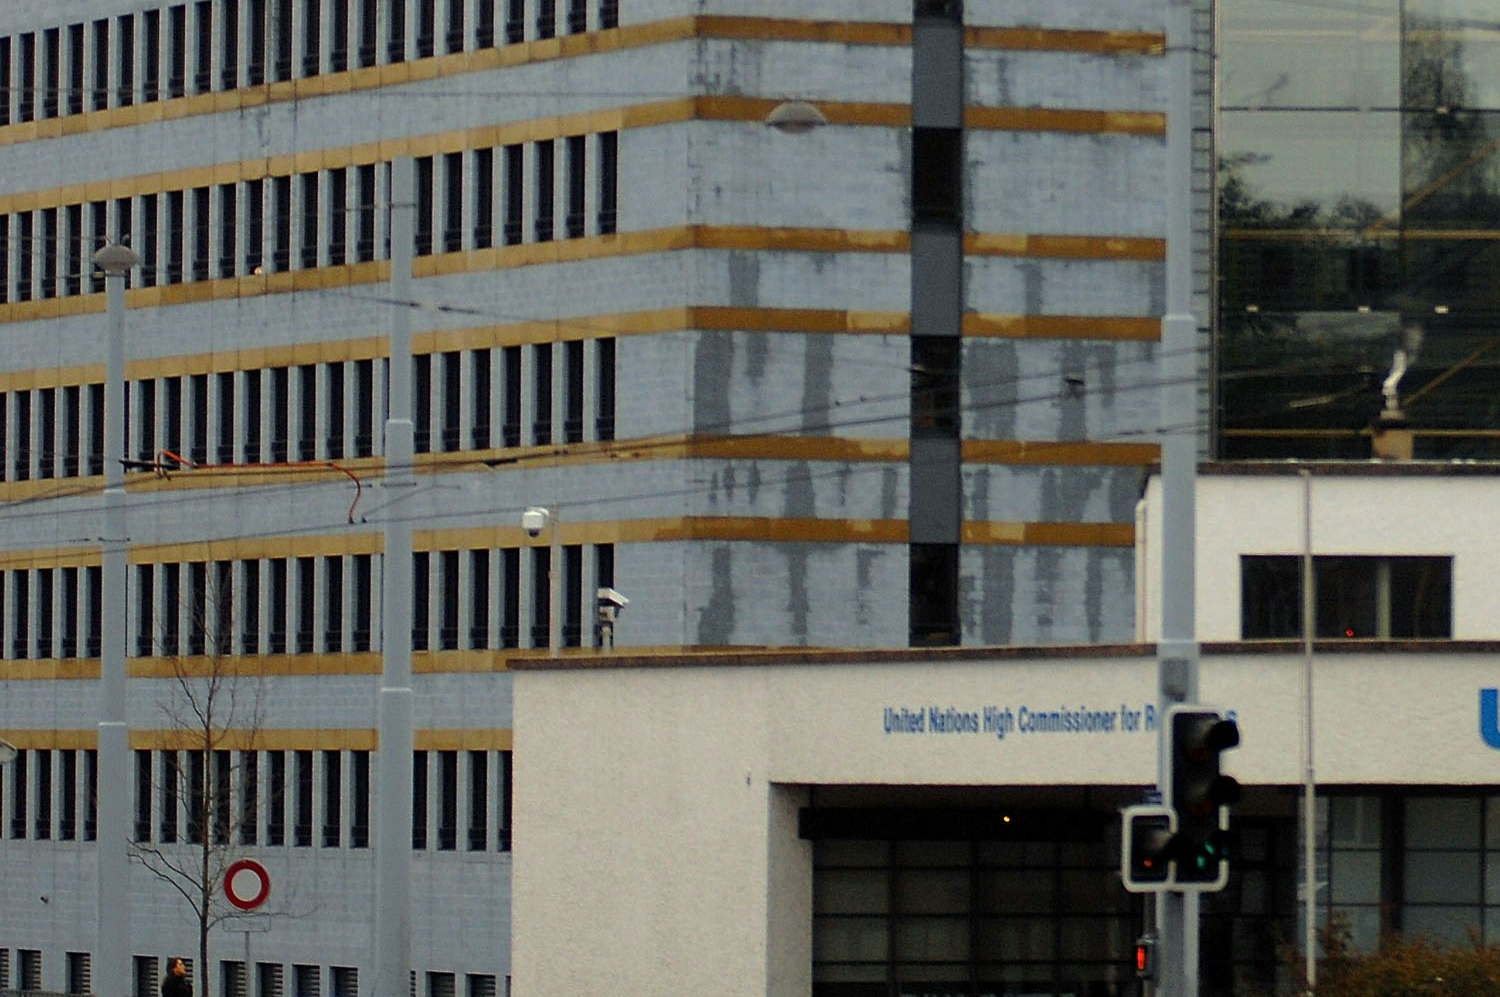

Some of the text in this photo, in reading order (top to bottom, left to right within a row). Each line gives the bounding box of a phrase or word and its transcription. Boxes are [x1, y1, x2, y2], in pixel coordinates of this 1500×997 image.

[883, 708, 925, 734] United
[928, 707, 978, 734] Nations
[983, 707, 1014, 740] High
[1018, 705, 1117, 734] Commissioner
[1121, 705, 1142, 732] for
